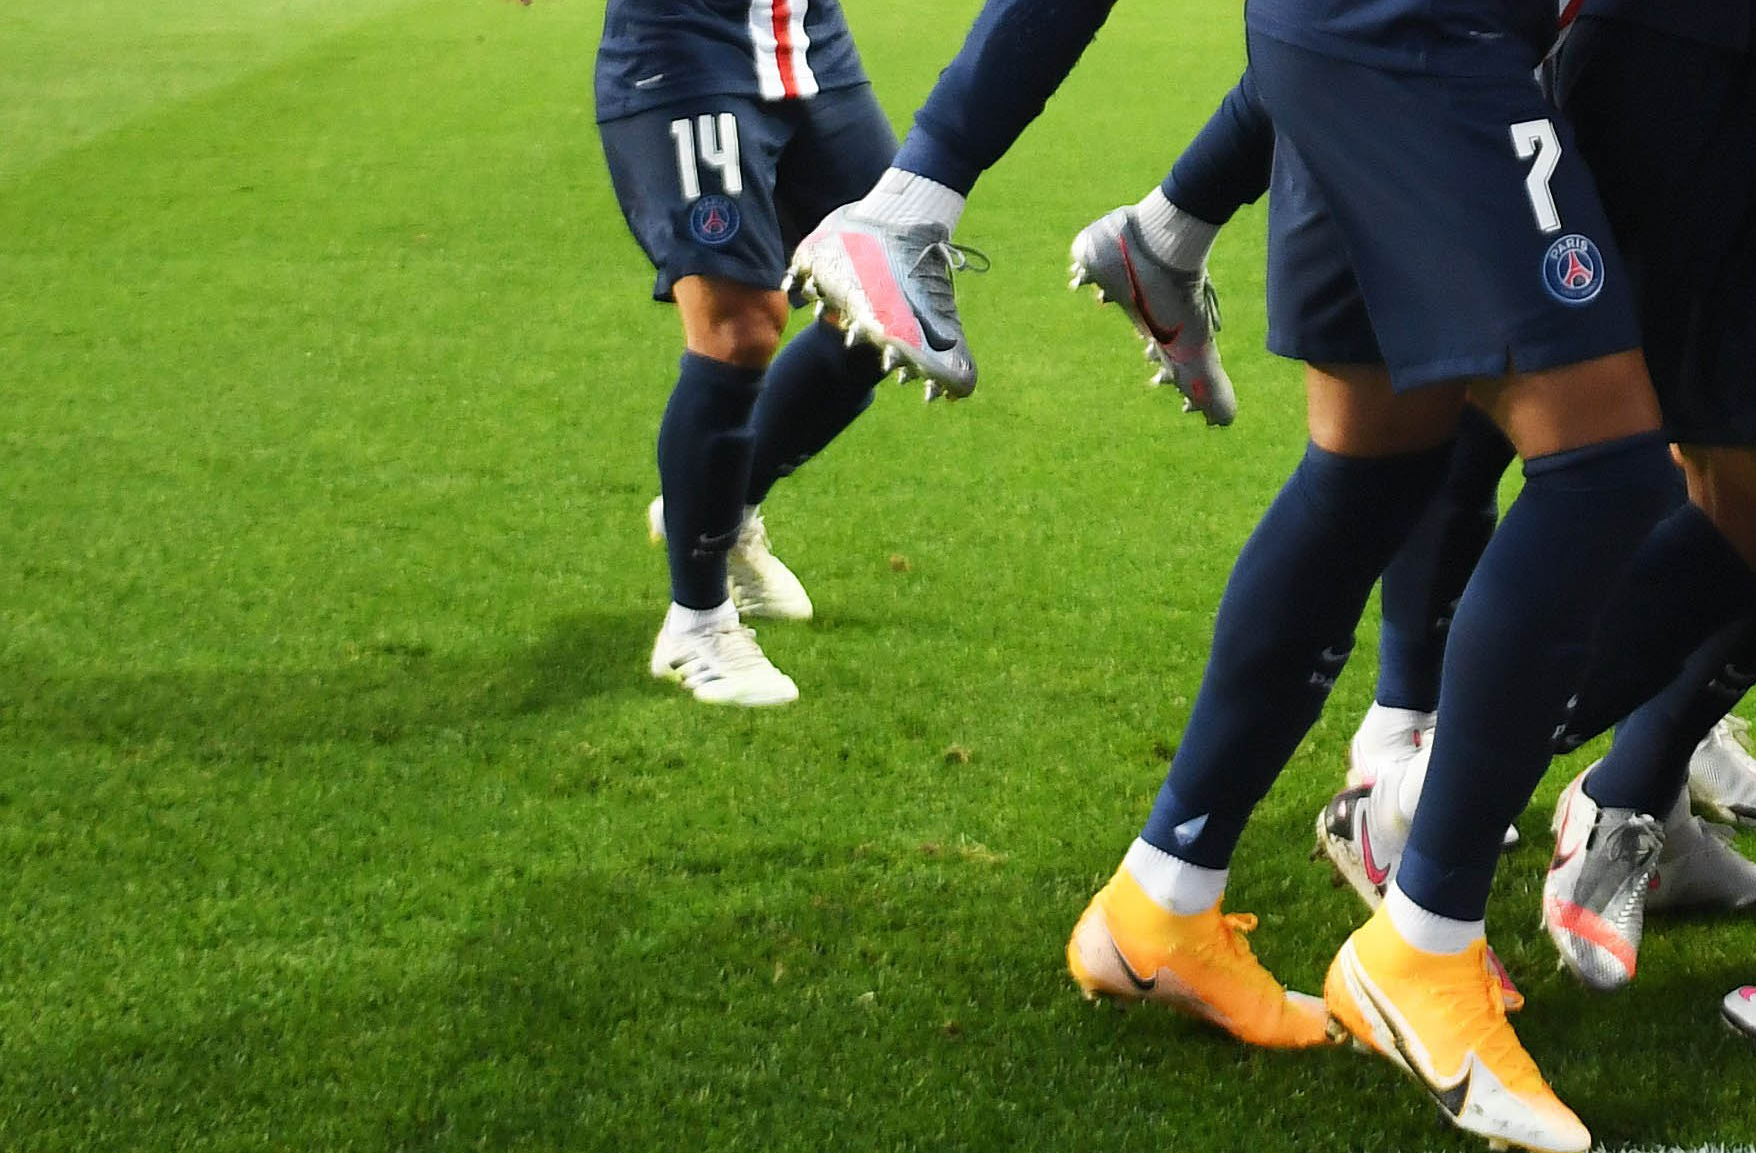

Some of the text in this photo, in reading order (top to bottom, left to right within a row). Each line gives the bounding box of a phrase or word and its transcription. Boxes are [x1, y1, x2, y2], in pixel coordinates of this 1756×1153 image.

[669, 112, 743, 199] 14
[1510, 119, 1562, 232] 7
[1550, 238, 1588, 260] PARIS
